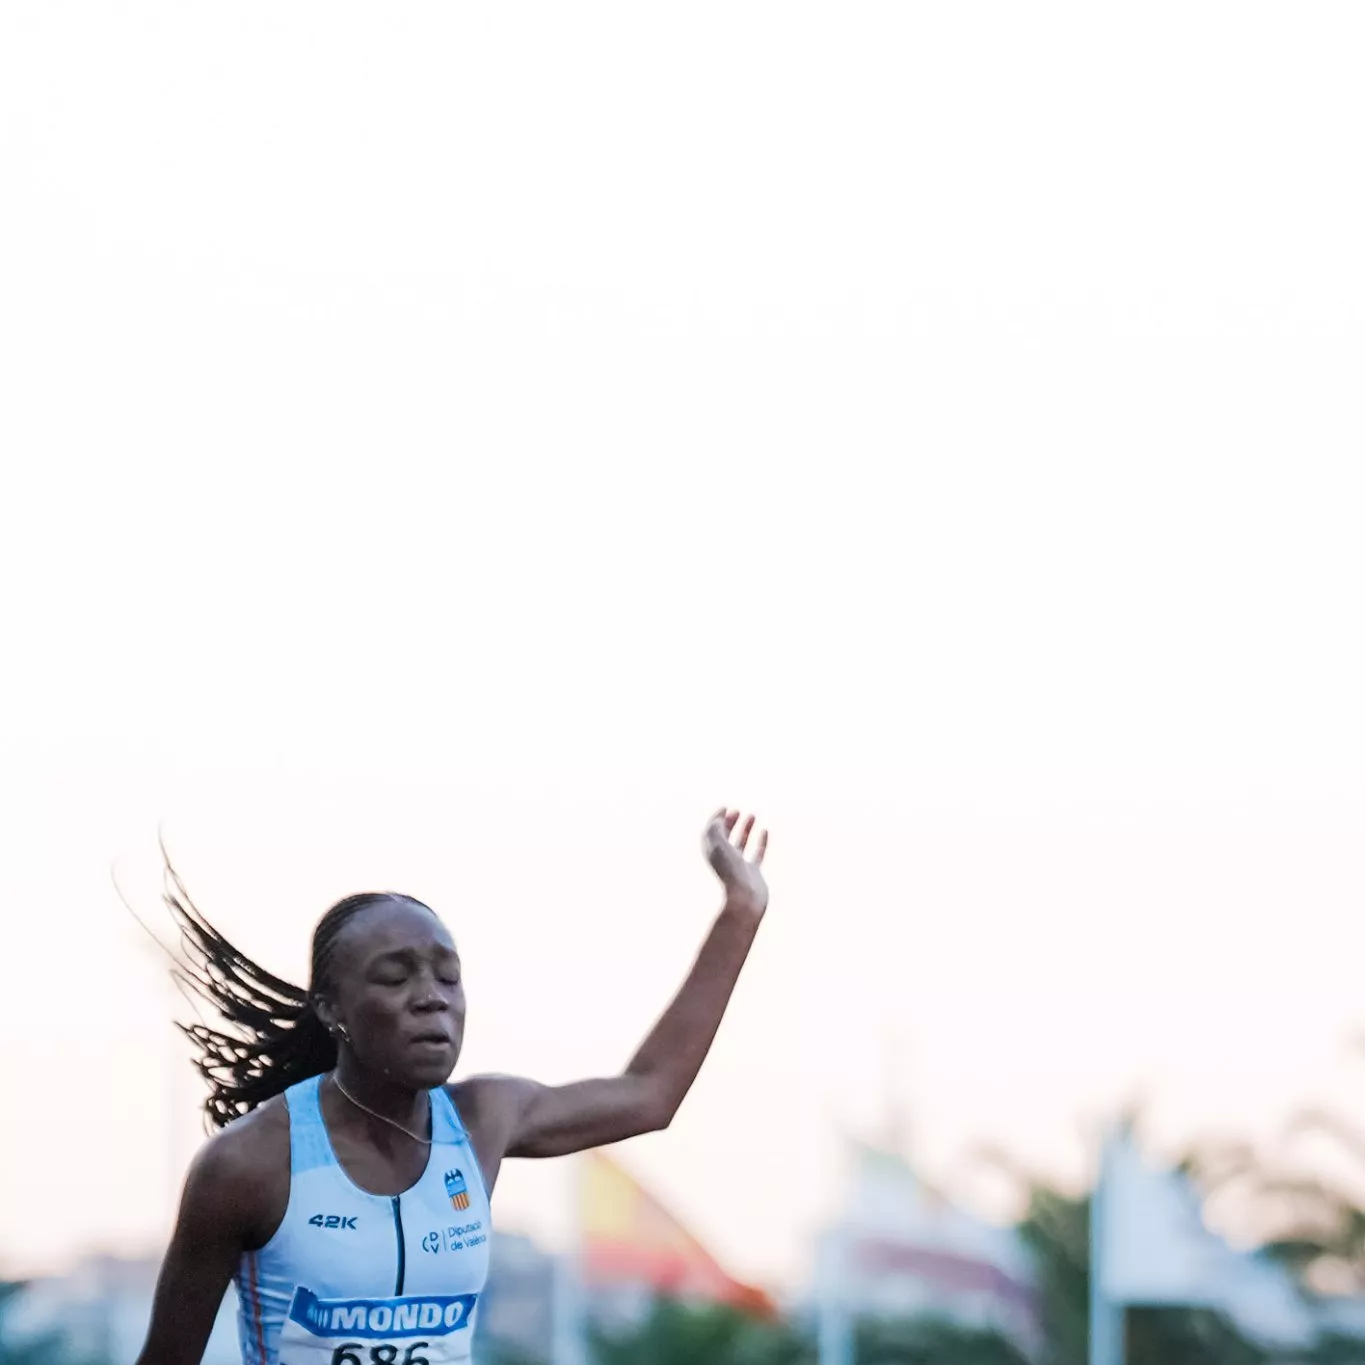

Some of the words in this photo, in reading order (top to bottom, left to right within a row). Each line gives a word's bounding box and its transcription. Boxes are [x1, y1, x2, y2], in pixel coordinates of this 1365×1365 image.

[308, 1214, 360, 1230] 42K
[450, 1241, 463, 1251] de
[331, 1301, 464, 1331] MONDO
